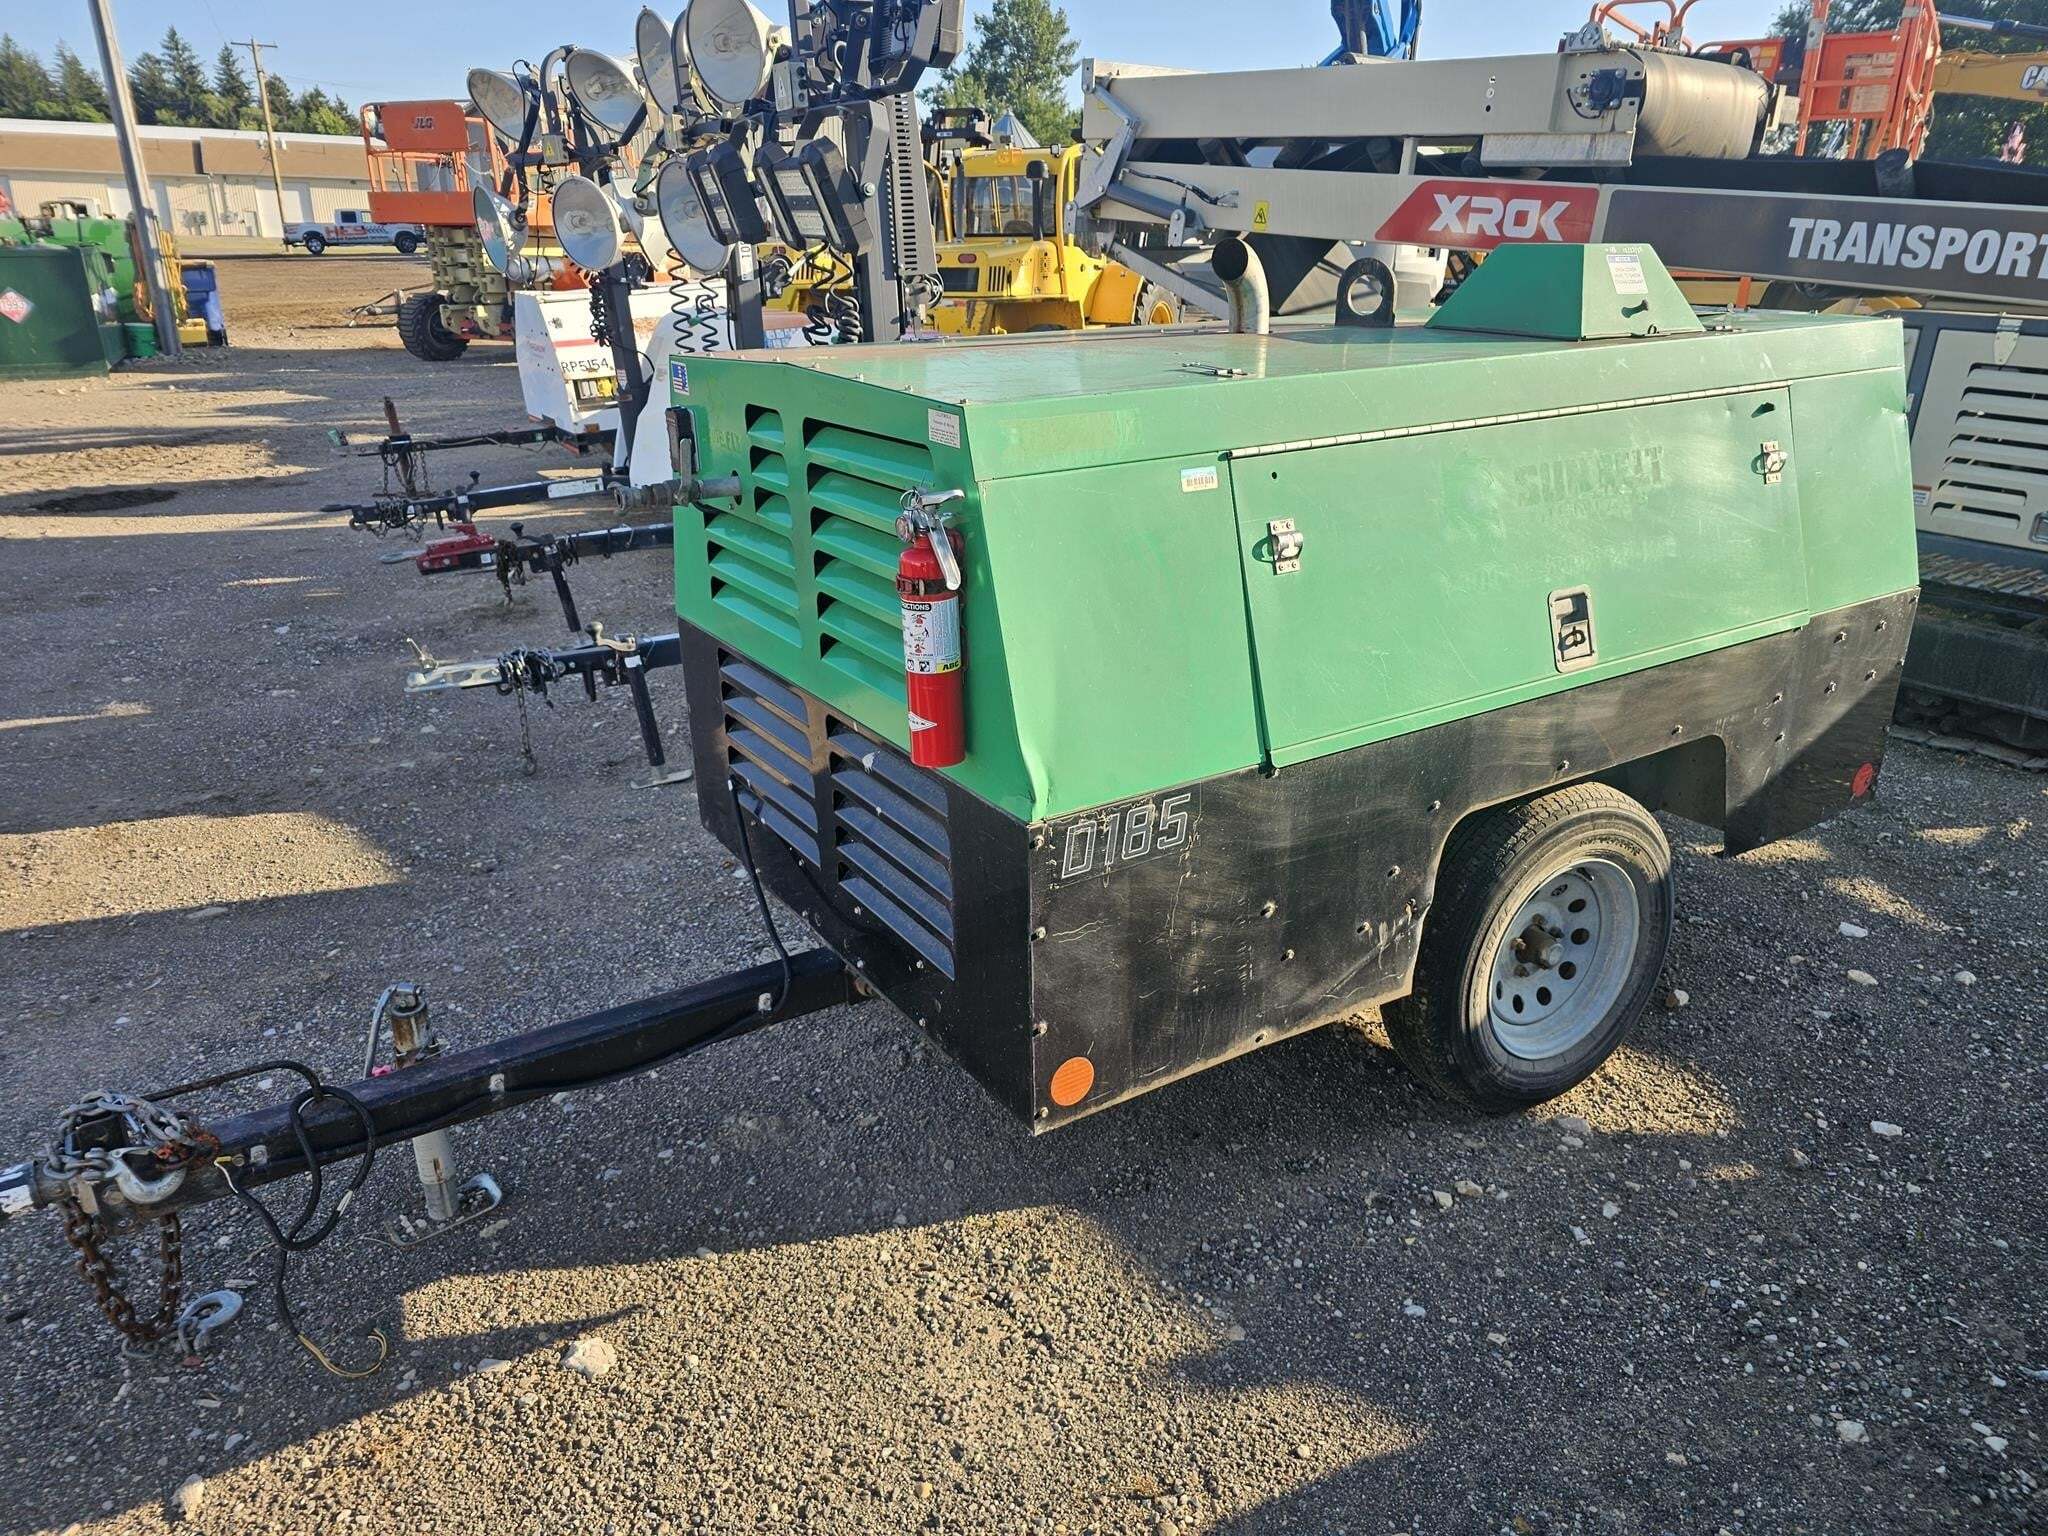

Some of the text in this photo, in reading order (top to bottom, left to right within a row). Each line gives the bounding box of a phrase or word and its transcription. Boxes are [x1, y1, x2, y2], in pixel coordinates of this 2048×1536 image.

[1428, 193, 1571, 241] XROK
[561, 358, 609, 374] RP5154
[943, 660, 960, 671] ABC
